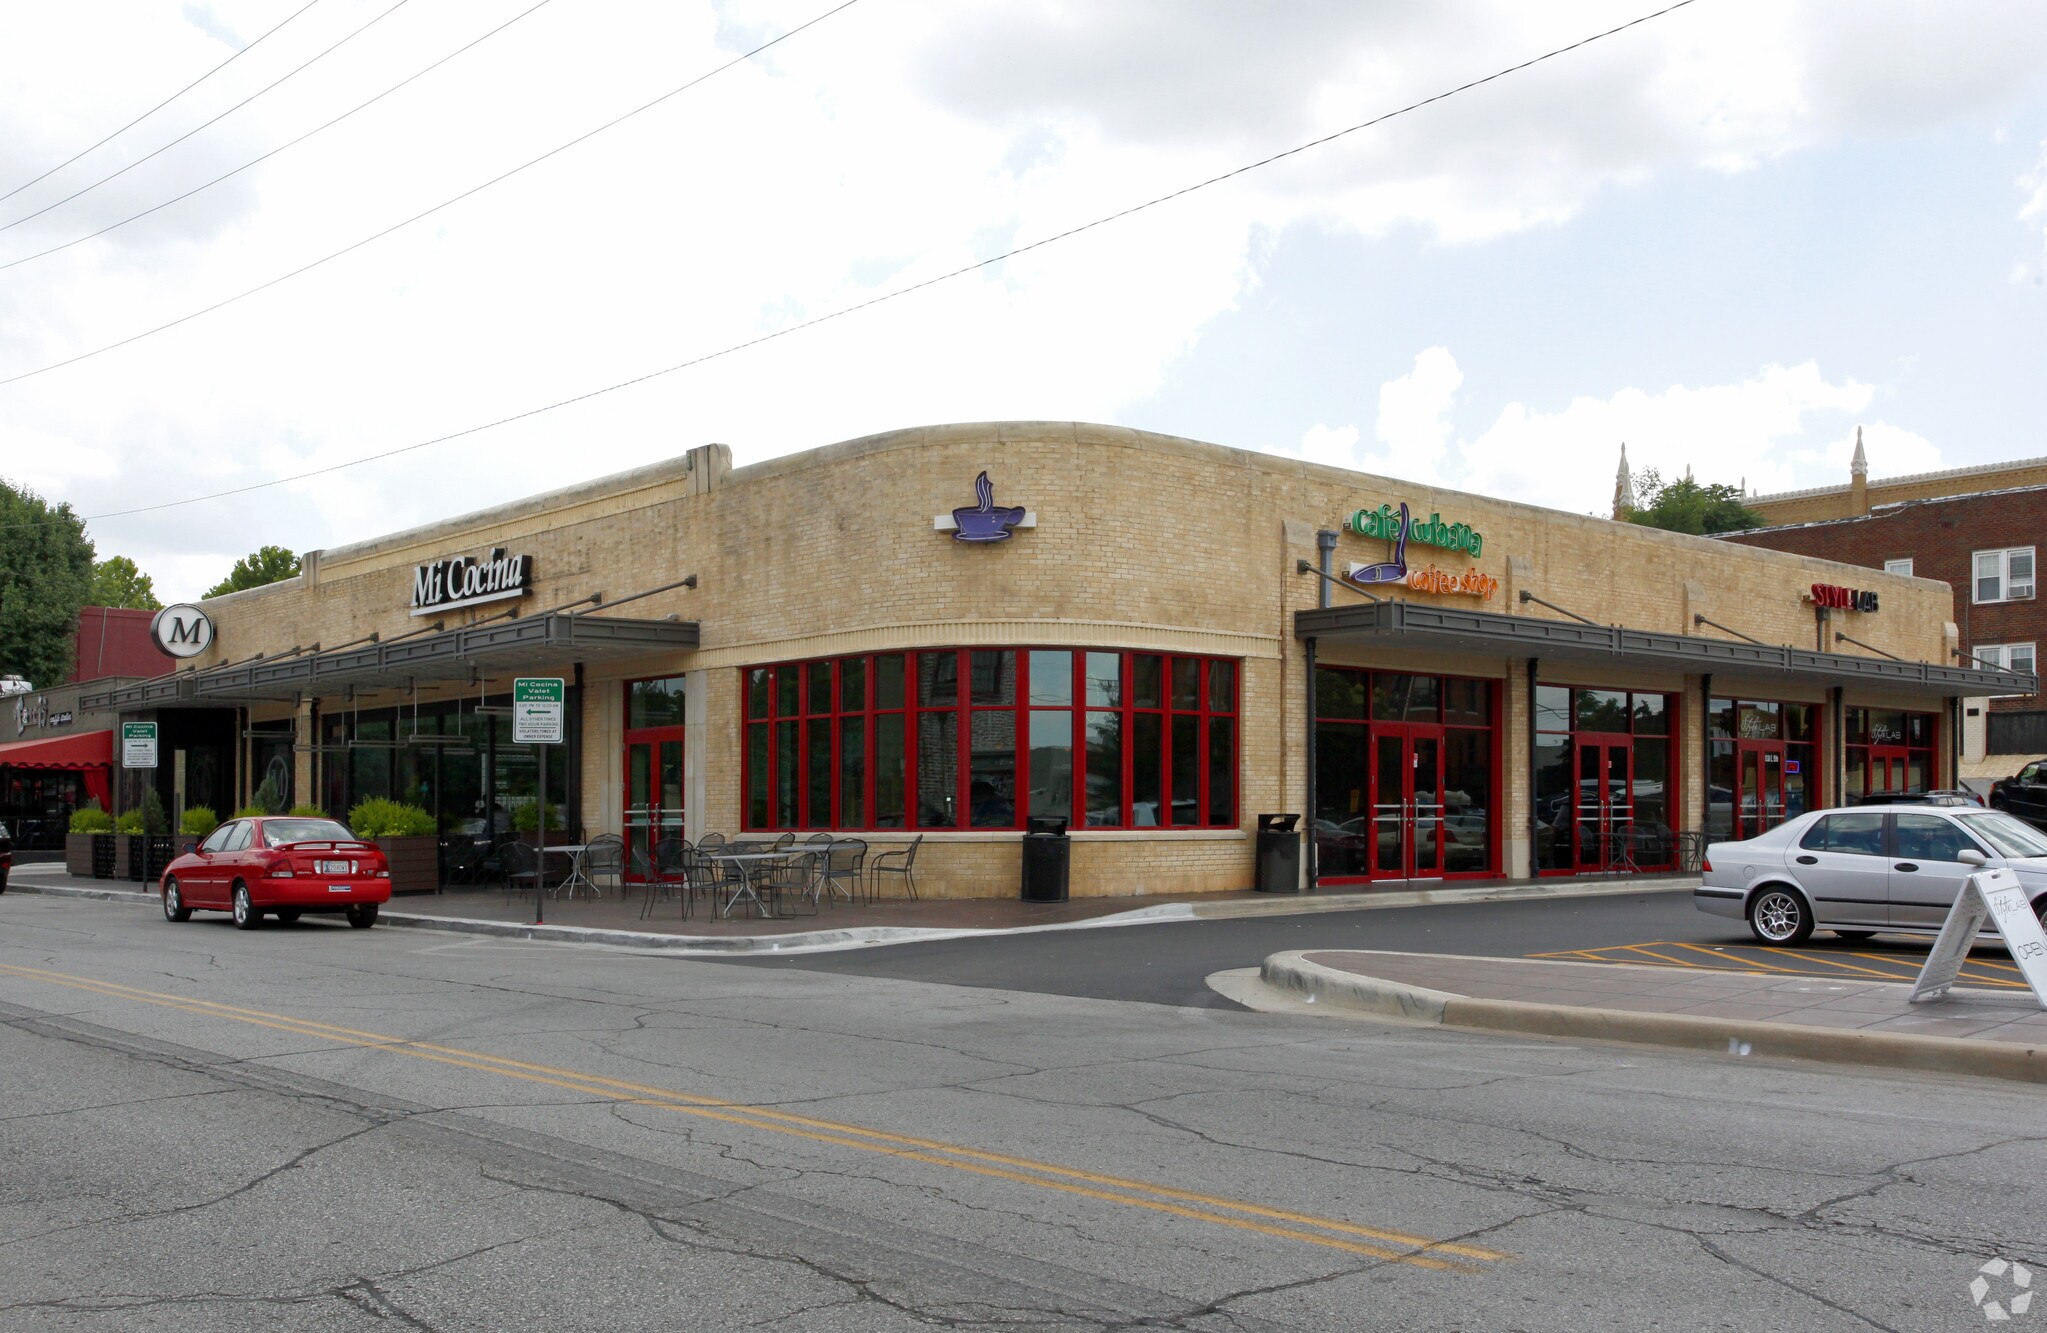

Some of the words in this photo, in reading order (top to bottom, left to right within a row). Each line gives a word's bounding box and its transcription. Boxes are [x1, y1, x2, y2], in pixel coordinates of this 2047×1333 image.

[1352, 503, 1402, 541] café
[1409, 512, 1483, 559] cubana
[410, 559, 443, 606] Mi
[447, 547, 525, 599] Cocina
[1407, 563, 1461, 594] coffee
[1459, 567, 1499, 600] shop
[168, 616, 205, 644] M
